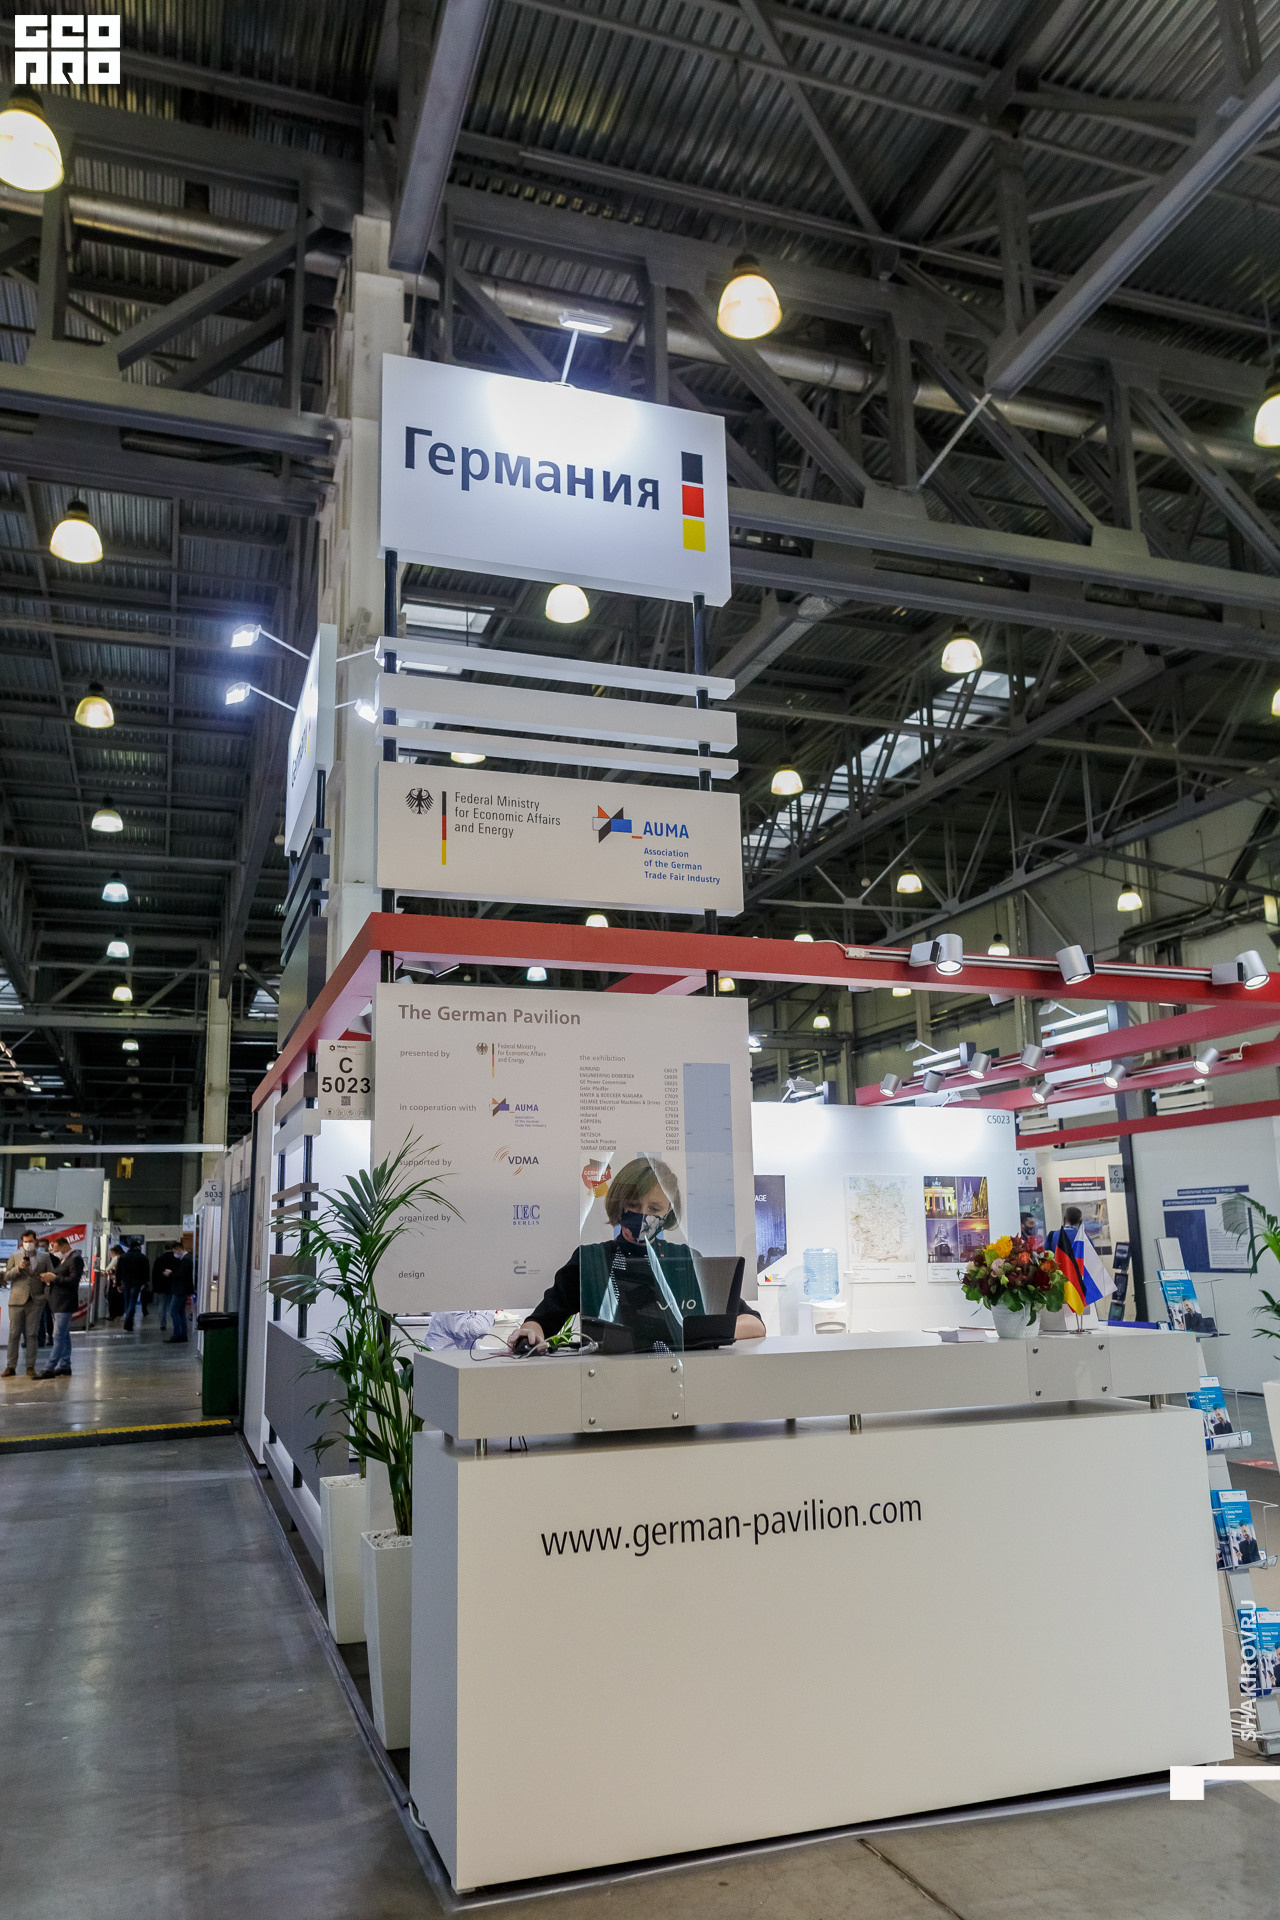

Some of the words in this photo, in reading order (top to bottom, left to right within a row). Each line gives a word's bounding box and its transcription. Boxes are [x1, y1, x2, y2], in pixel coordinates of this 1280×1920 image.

[404, 426, 660, 511] Германия
[455, 792, 493, 806] Federal
[497, 794, 540, 811] Ministry
[454, 807, 470, 818] for
[473, 808, 523, 823] Economic
[526, 811, 561, 826] Affairs
[454, 822, 474, 833] and
[478, 823, 514, 839] Energy
[643, 821, 689, 839] AUMA
[644, 847, 689, 858] Association
[644, 859, 653, 868] of
[655, 859, 668, 869] the
[671, 861, 702, 871] German
[644, 871, 667, 881] Trade
[669, 872, 685, 882] Fair
[687, 873, 721, 885] Industry
[398, 1003, 432, 1021] The
[437, 1006, 507, 1023] German
[513, 1008, 581, 1025] Pavilion
[400, 1049, 439, 1059] presented
[440, 1049, 450, 1059] by
[339, 1057, 353, 1073] C
[322, 1077, 371, 1094] 5023
[399, 1103, 406, 1112] in
[408, 1103, 457, 1114] cooperation
[458, 1103, 477, 1112] with
[987, 1115, 1011, 1124] C5023
[398, 1158, 438, 1167] supported
[442, 1158, 452, 1167] by
[508, 1155, 539, 1166] VDMA
[1017, 1167, 1036, 1175] 5023
[398, 1213, 439, 1223] organized
[441, 1213, 451, 1223] by
[513, 1204, 541, 1220] IEC
[398, 1270, 425, 1280] design
[656, 1298, 697, 1311] VIO
[540, 1497, 922, 1557] www.german-pavilion.com
